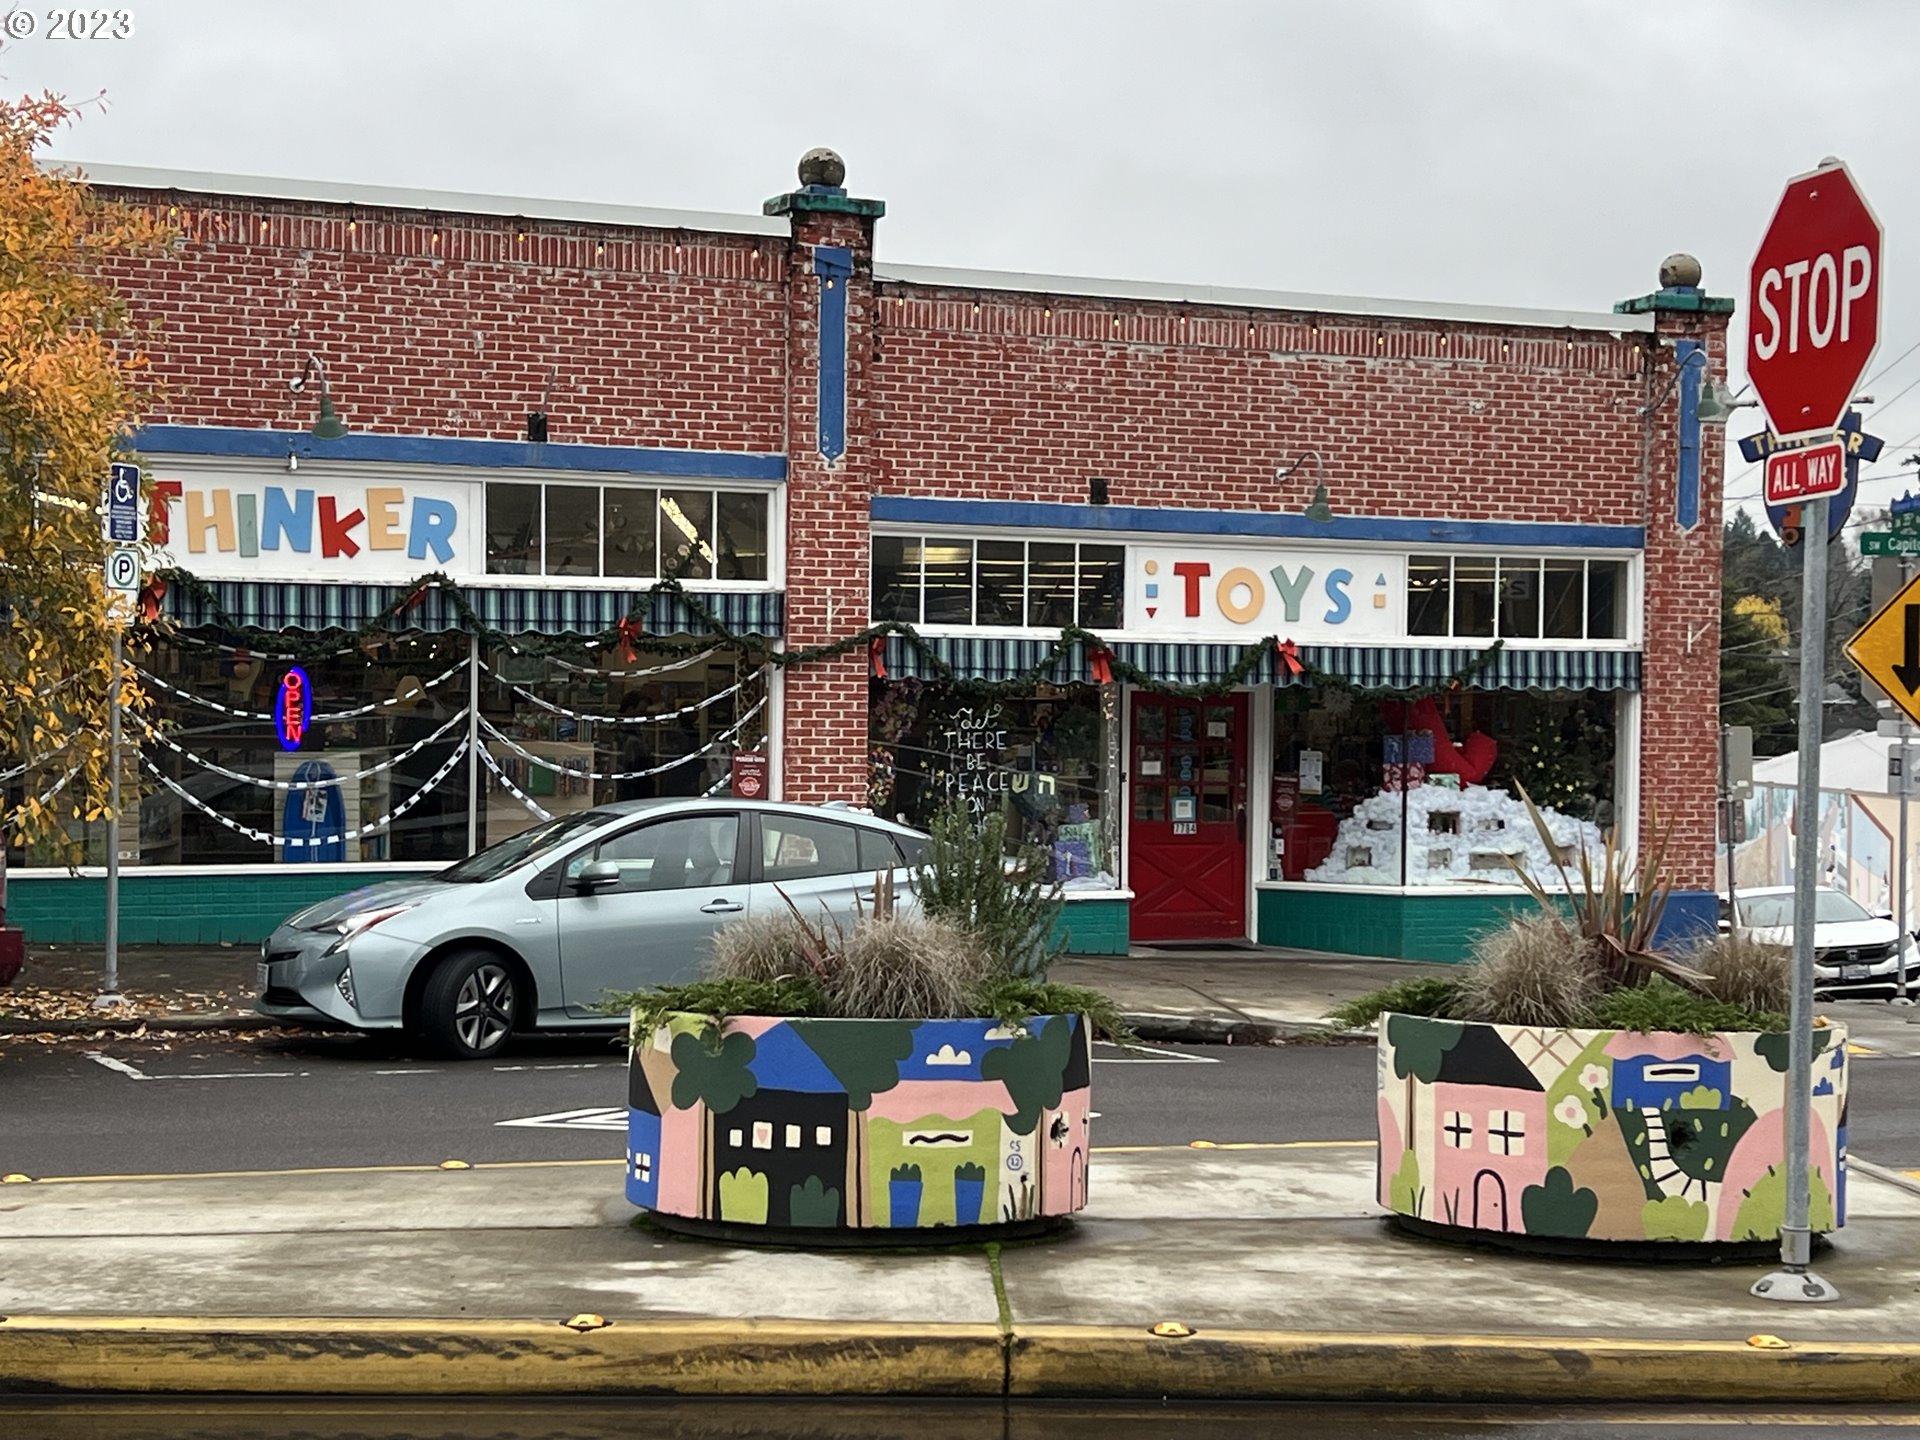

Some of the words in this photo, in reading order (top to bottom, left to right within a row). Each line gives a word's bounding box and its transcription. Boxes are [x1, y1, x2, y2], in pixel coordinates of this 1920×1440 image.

[1754, 245, 1873, 361] STOP
[1772, 462, 1801, 494] ALL
[1806, 453, 1838, 487] WAY
[149, 481, 458, 564] THINKER
[119, 559, 130, 580] P
[1173, 562, 1354, 625] TOYS
[283, 672, 303, 743] OPEN
[943, 730, 1007, 751] THERE
[946, 771, 1009, 793] PEACE
[966, 753, 987, 770] BE
